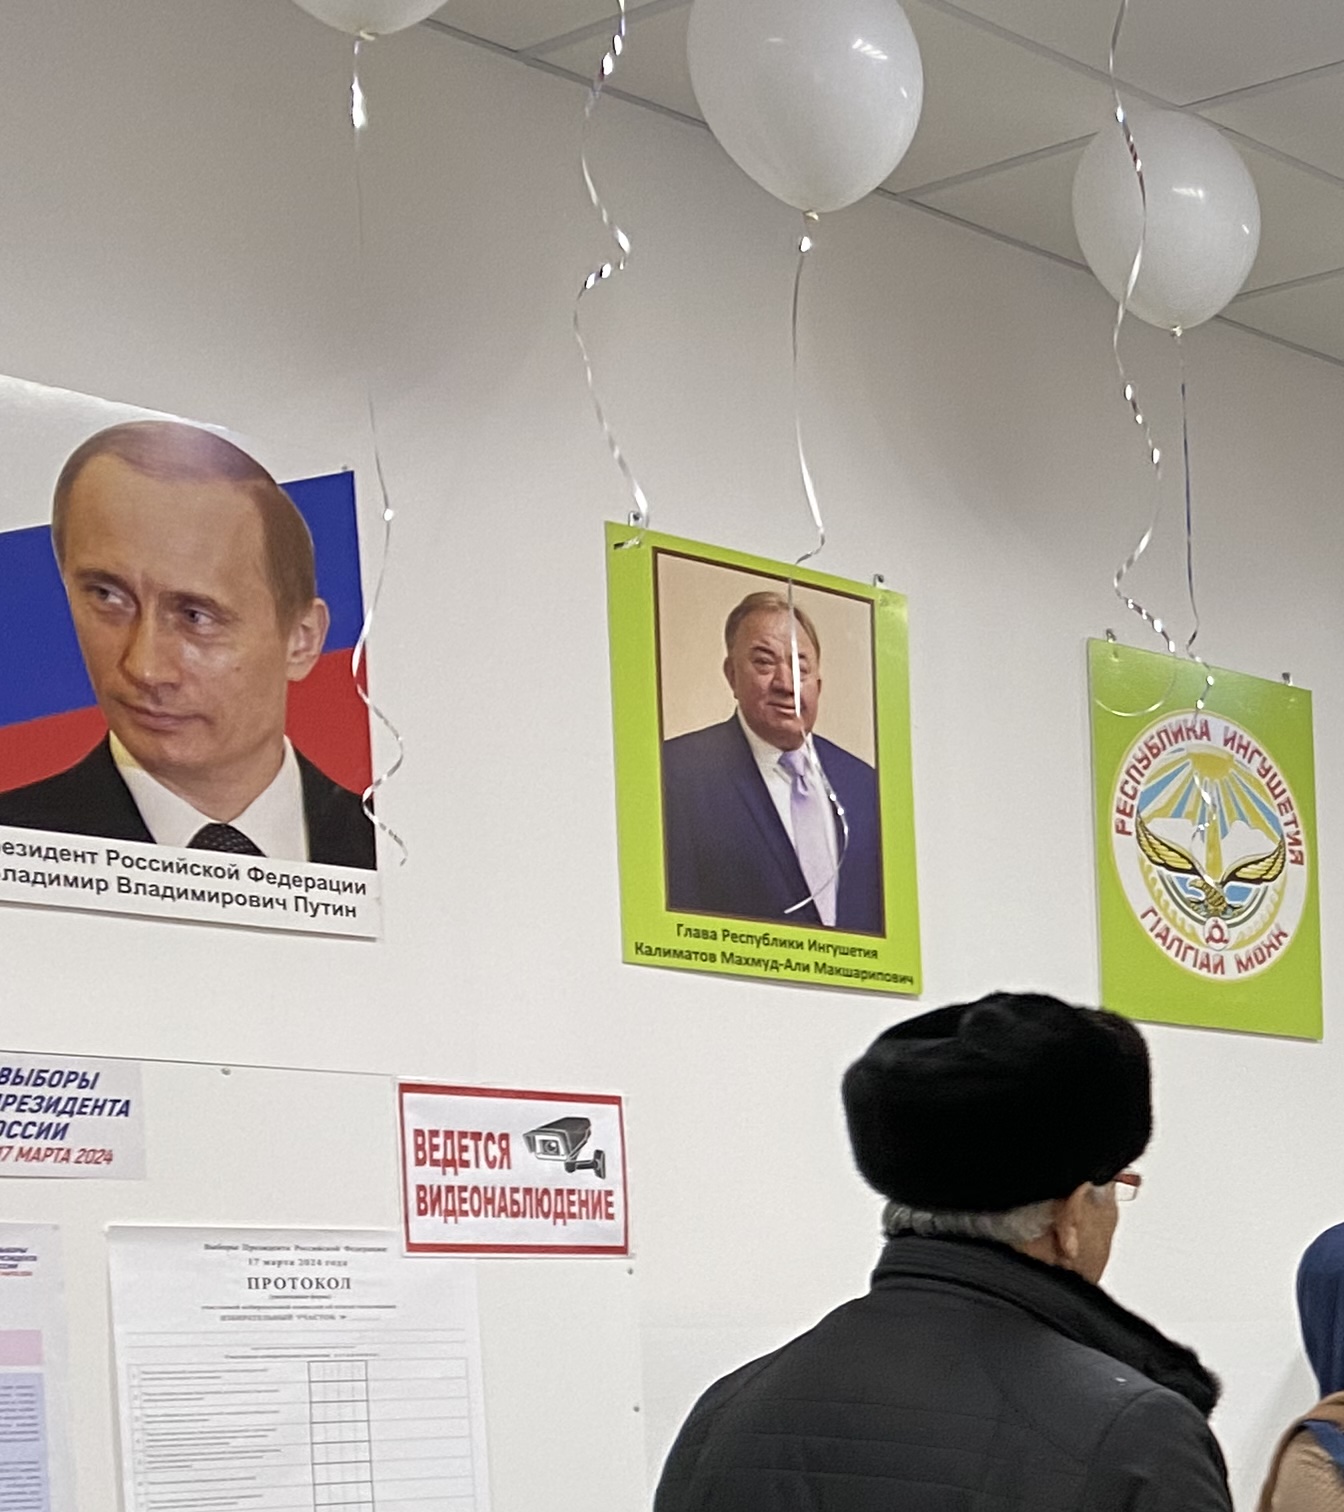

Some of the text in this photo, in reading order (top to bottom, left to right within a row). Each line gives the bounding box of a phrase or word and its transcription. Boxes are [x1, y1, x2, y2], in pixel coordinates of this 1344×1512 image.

[1223, 725, 1304, 866] ИНГУШЕТИЯ
[0, 841, 367, 897] езидент Российской Федерации
[0, 868, 357, 919] ладимир Владимирович Путин
[676, 924, 878, 960] Глава Республики Ингушетия
[635, 942, 914, 985] Калиматов Махмуд-Али Макшарипович
[0, 1067, 100, 1090] ВЫБОРЫ
[15, 1146, 71, 1163] МАРТА
[74, 1148, 113, 1165] 2024
[413, 1128, 512, 1176] ВЕДЕТСЯ
[416, 1184, 615, 1226] ВИДЕОНАБЛЮДЕНИЕ
[247, 1277, 352, 1290] ПРОТОКОЛ
